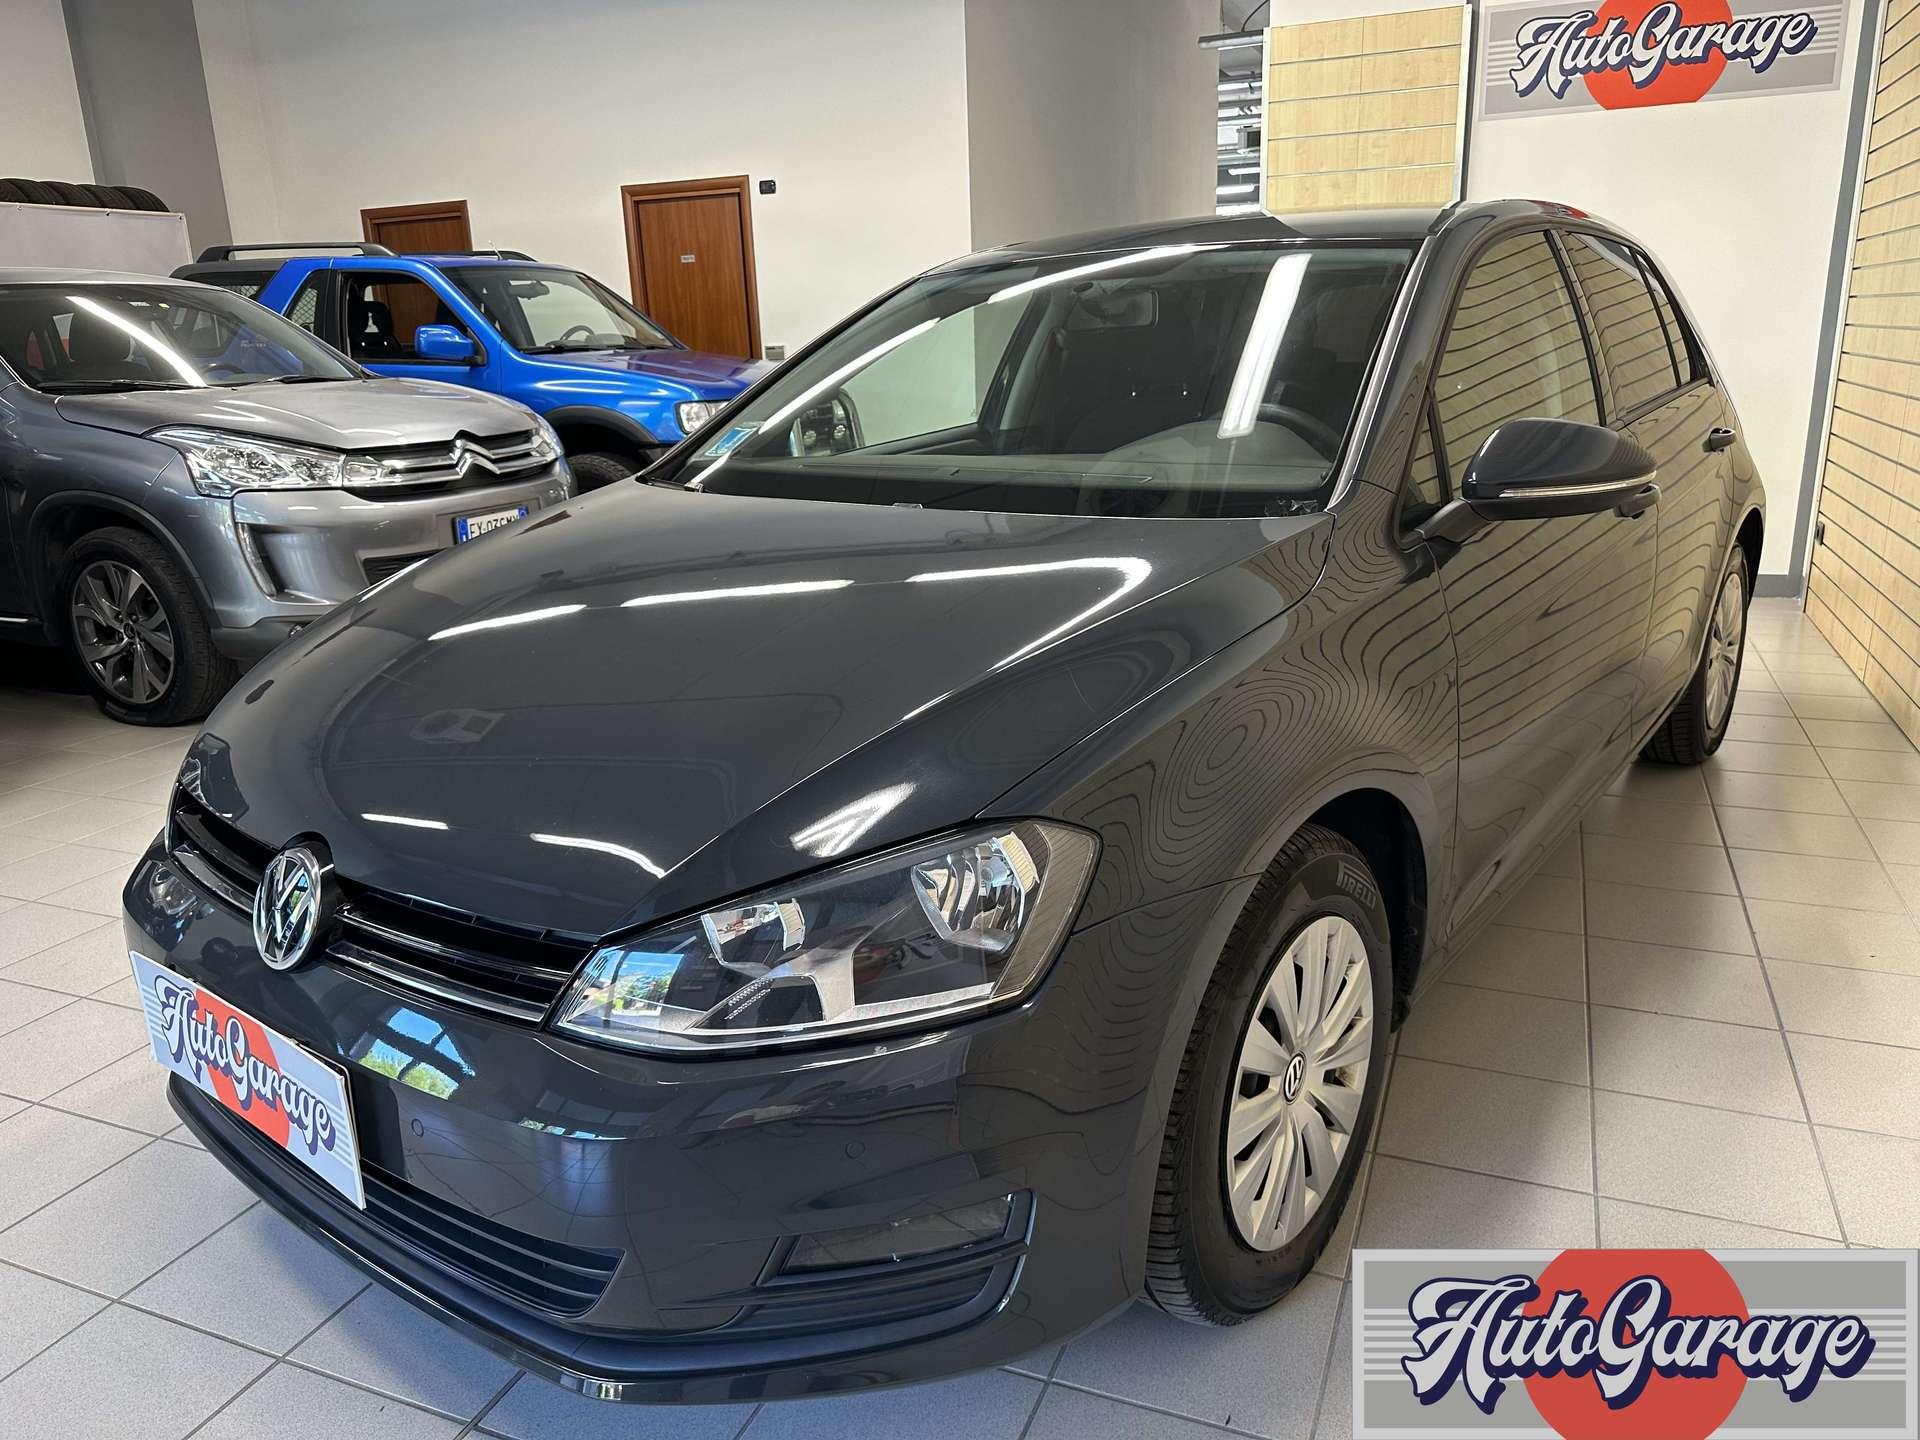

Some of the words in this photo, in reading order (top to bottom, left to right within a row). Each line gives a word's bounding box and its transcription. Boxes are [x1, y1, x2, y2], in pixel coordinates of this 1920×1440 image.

[1509, 2, 1818, 98] AutoGarage
[1336, 861, 1377, 909] PIRELLI
[154, 975, 336, 1155] AutoGarage
